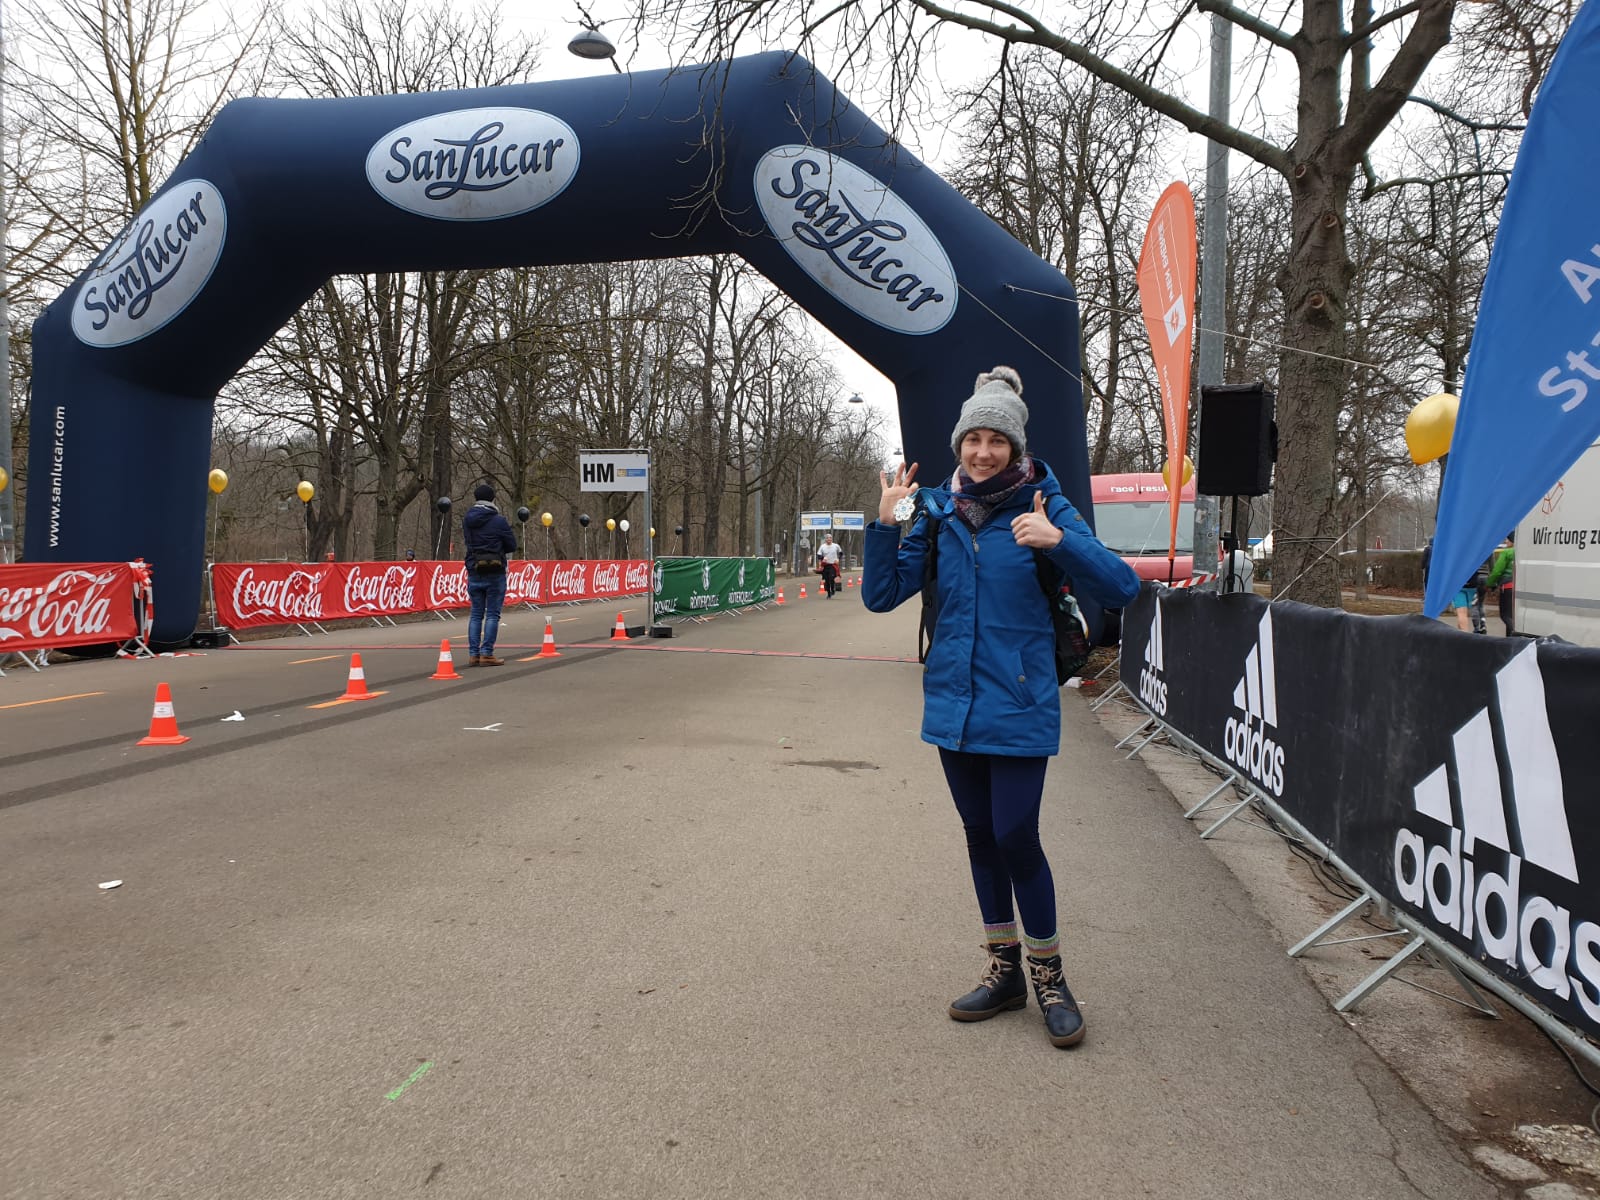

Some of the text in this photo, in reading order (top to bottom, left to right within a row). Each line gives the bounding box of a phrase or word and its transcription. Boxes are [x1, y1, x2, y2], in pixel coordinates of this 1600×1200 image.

[385, 121, 563, 201] SanLucar
[84, 191, 207, 331] SanLucar
[772, 158, 944, 312] SanLucar
[1560, 243, 1600, 305] A
[1538, 331, 1600, 412] St
[49, 406, 66, 547] www.sanlucar.com
[583, 463, 615, 483] HM
[1110, 484, 1168, 493] race resul
[1533, 526, 1552, 545] Wir
[233, 567, 327, 620] Coca-Cola
[345, 565, 417, 613] Coca-Cola
[551, 563, 587, 596] Coca-Cola
[593, 563, 621, 593] Coca-Cola
[1140, 668, 1168, 717] adidas
[1225, 710, 1285, 797] adidas
[1395, 826, 1600, 1025] adidas
